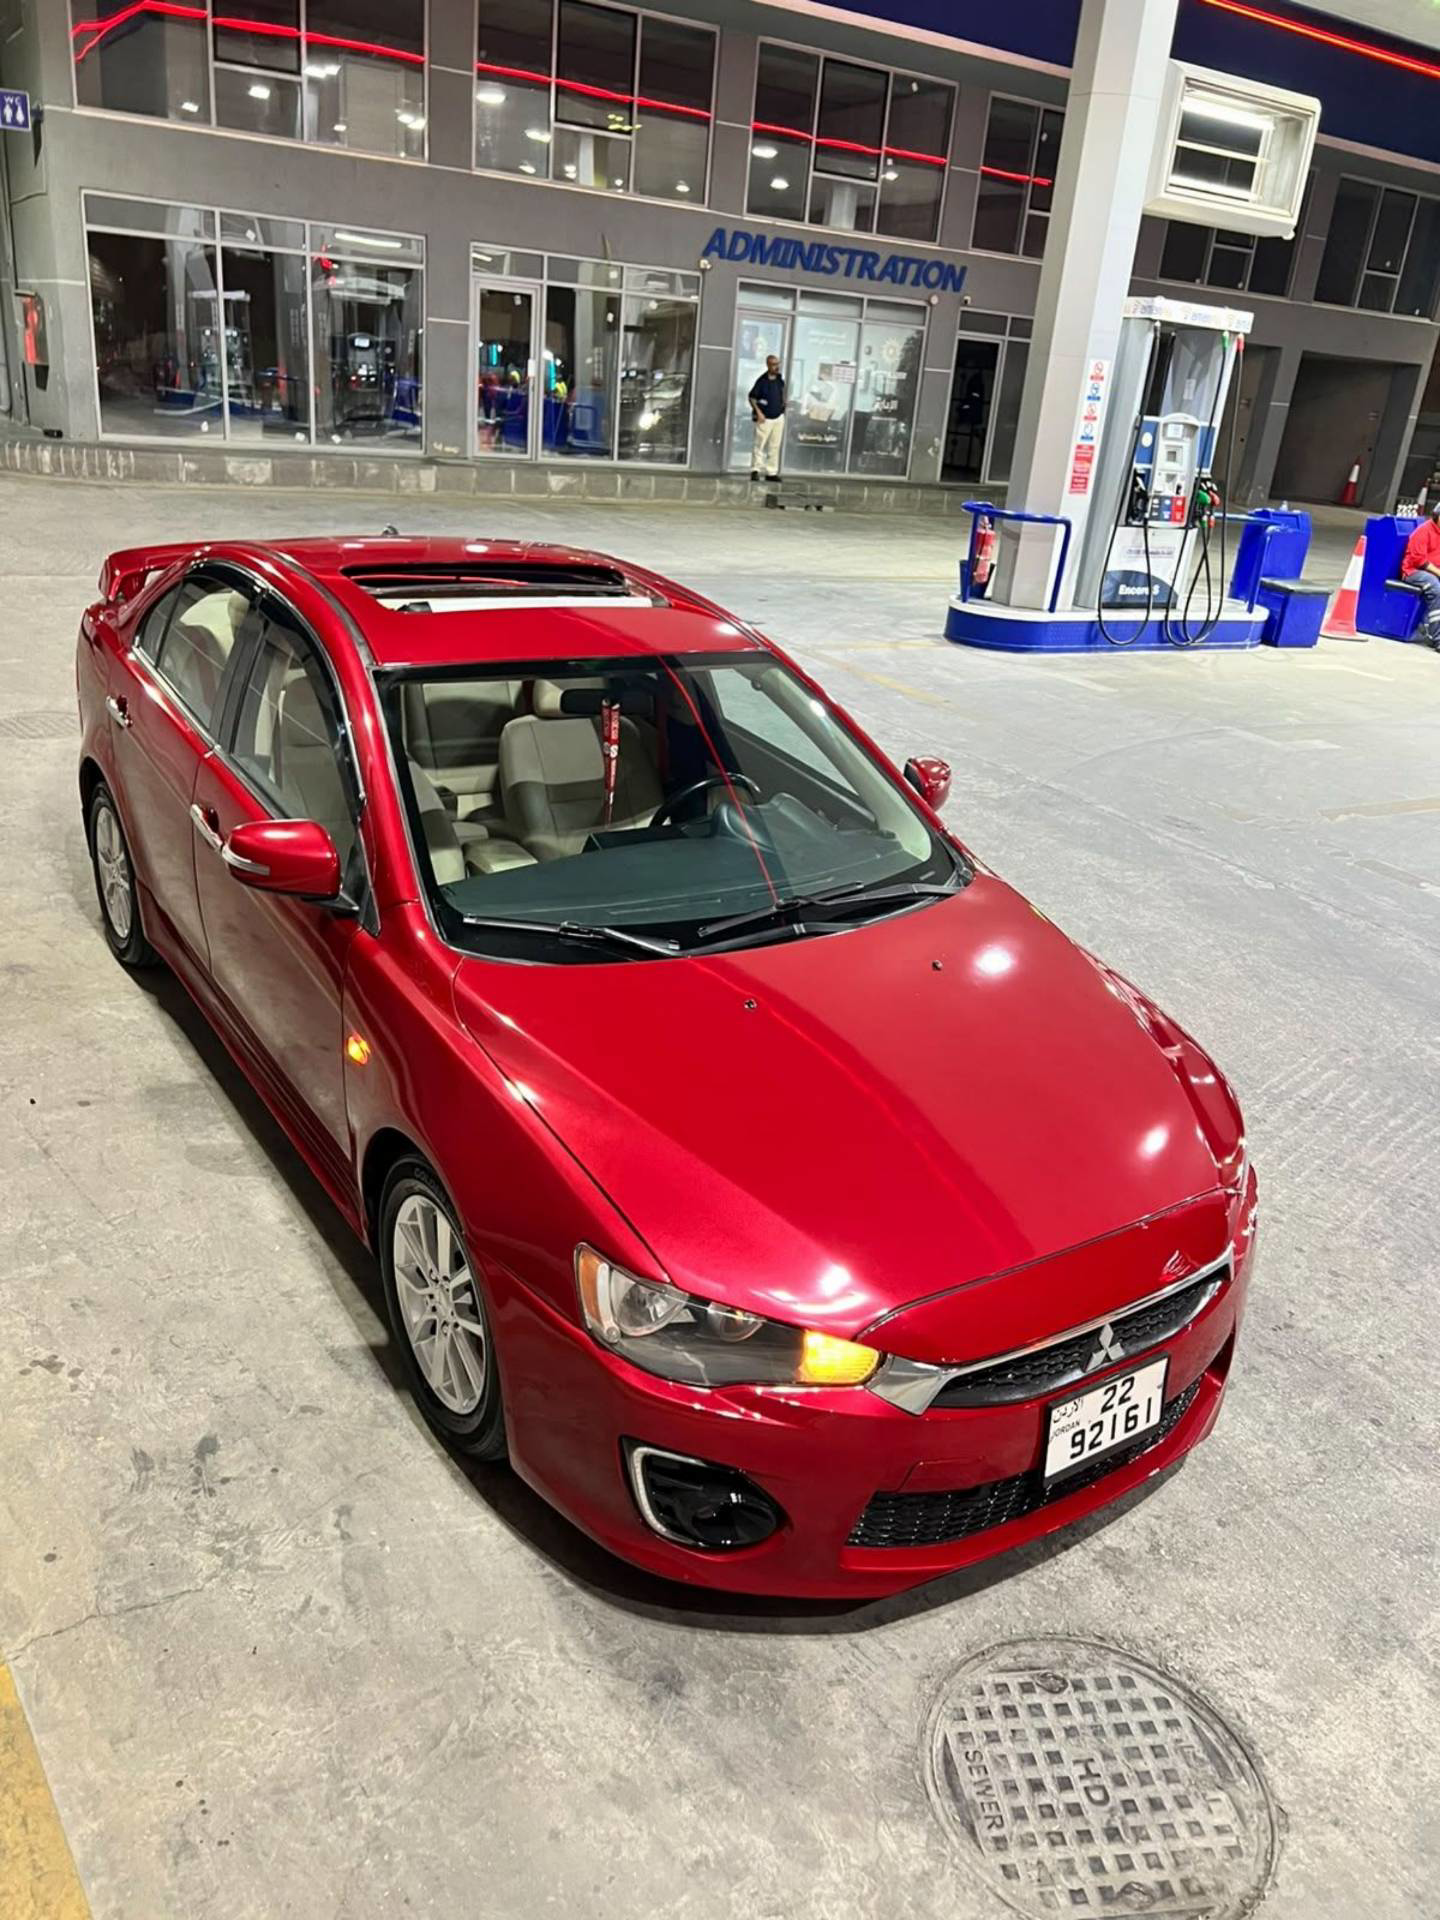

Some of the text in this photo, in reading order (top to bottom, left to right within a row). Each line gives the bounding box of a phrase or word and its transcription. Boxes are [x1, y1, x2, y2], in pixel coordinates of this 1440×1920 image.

[4, 96, 21, 104] WC
[702, 228, 967, 292] ADMINISTRATION
[1101, 1376, 1135, 1414] 22
[1070, 1397, 1152, 1459] 92161
[965, 1749, 1005, 1831] SEWER
[1072, 1757, 1110, 1807] HD
